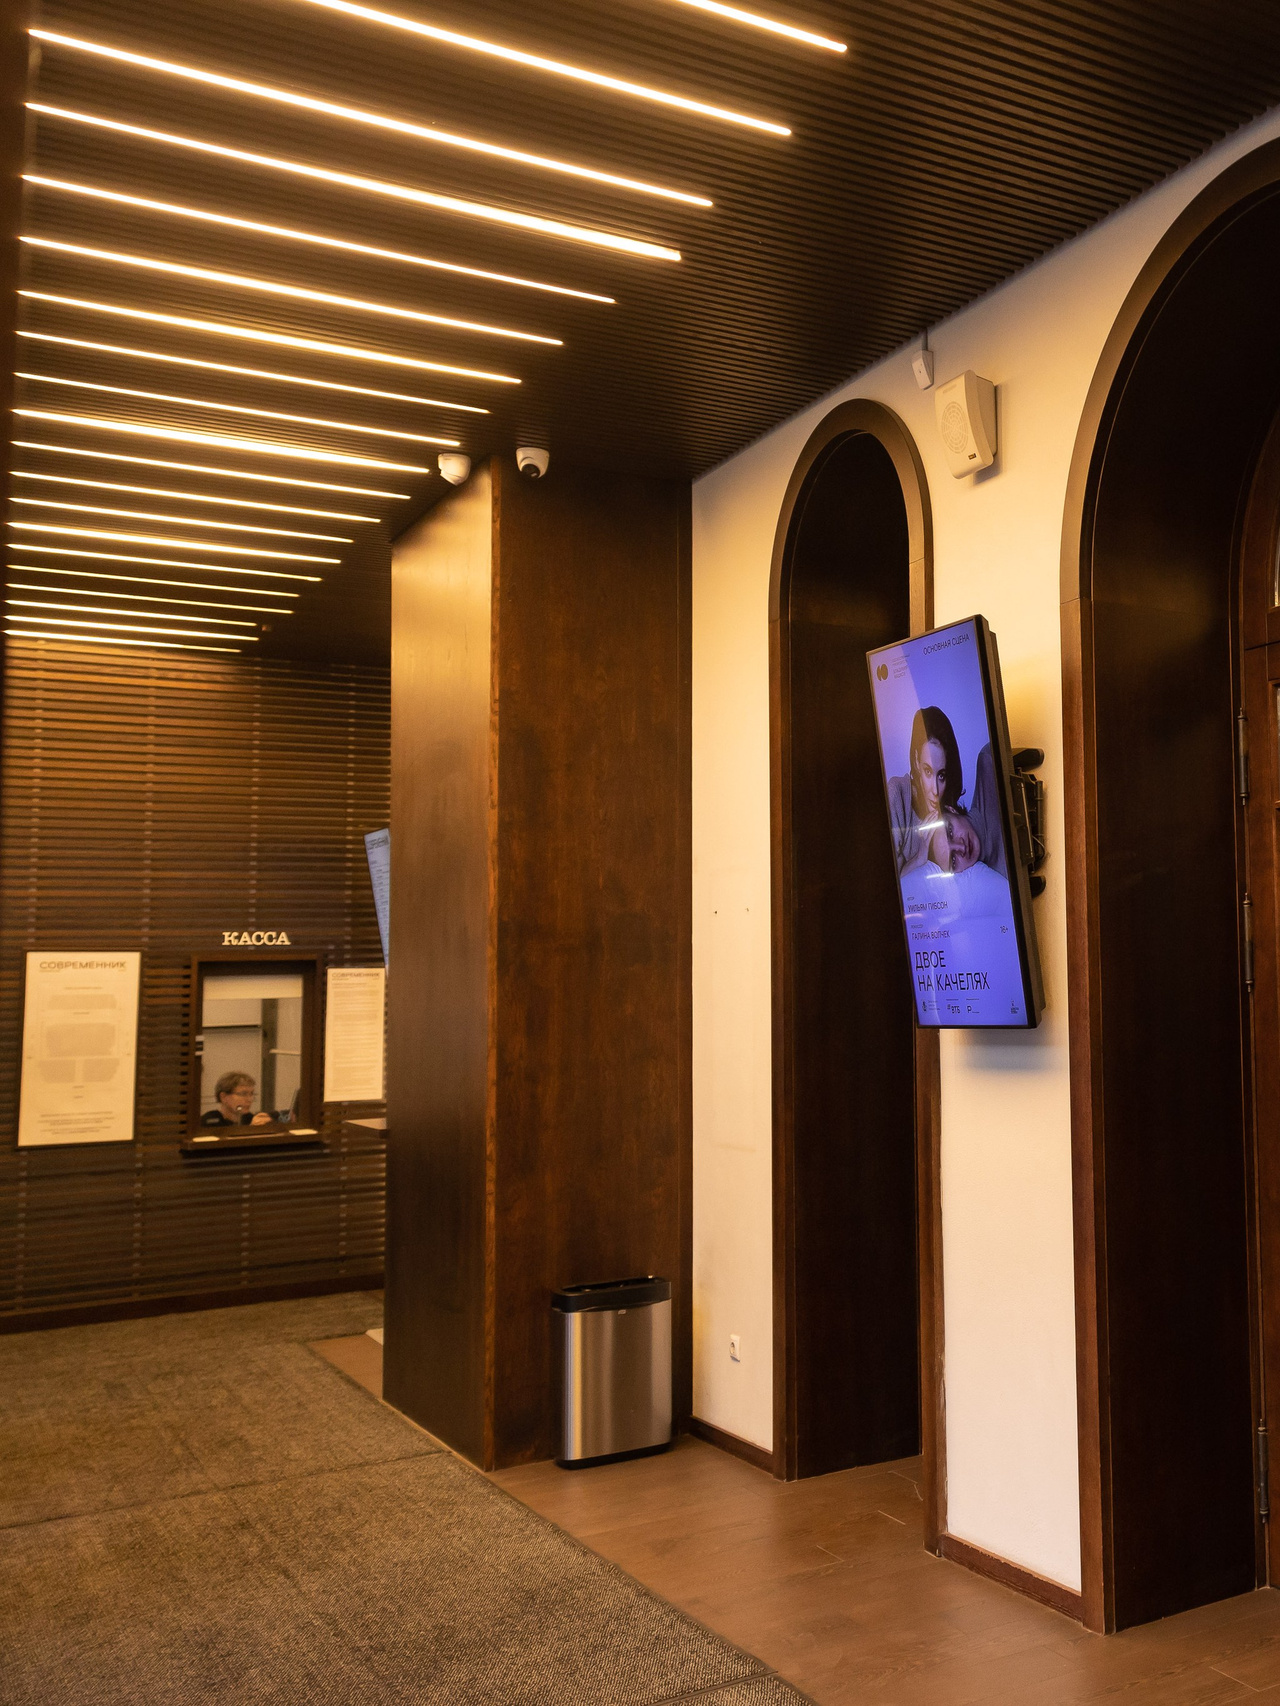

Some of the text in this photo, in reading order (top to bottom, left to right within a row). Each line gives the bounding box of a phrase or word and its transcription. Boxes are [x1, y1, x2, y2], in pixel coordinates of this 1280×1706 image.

[923, 633, 970, 656] ОСНОВНАЯ СЦЕНА
[928, 901, 948, 910] ГИБСОН
[222, 931, 291, 946] КАССА
[912, 930, 950, 940] ГАЛИНА ВОЛЧЕК
[39, 960, 127, 971] СОВРЕМЕННИК
[915, 950, 946, 972] ДВОЕ
[917, 972, 990, 991] НА КАЧЕЛЯХ
